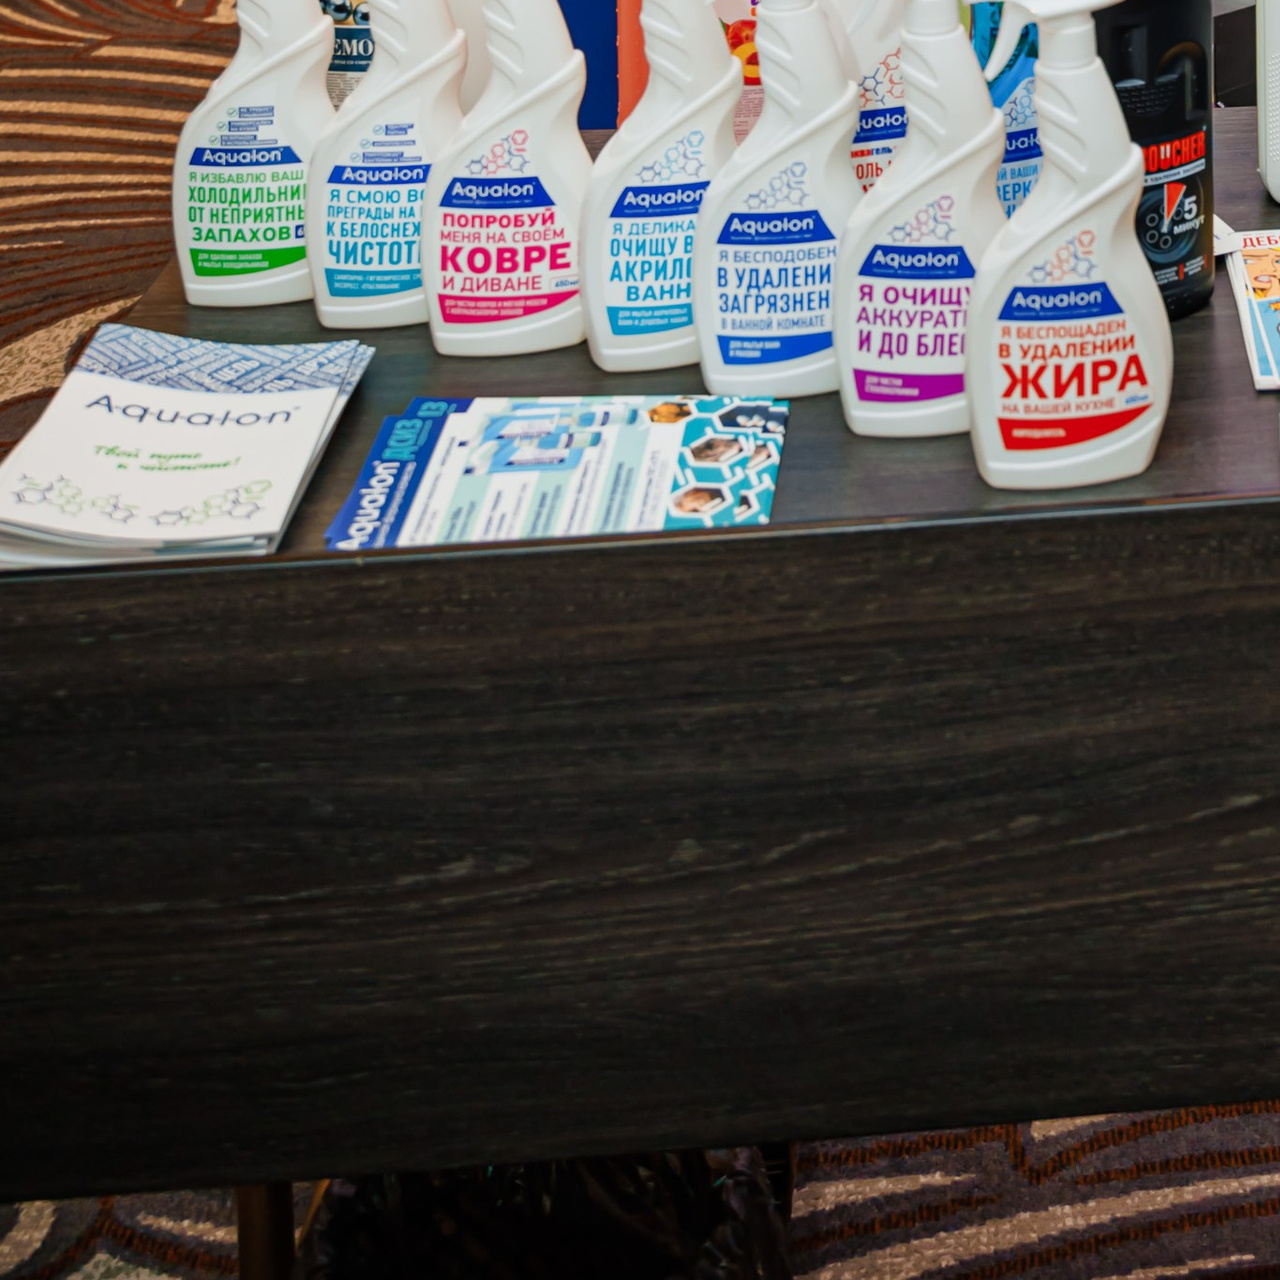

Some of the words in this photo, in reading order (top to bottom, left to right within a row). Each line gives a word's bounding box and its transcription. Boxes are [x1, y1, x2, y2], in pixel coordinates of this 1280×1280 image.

[203, 148, 281, 165] Aqualon
[189, 172, 197, 183] Я
[201, 172, 266, 184] ИЗБАВЛЮ
[342, 167, 424, 183] Aqualon
[330, 189, 341, 203] Я
[347, 189, 400, 204] СМОЮ
[451, 181, 534, 200] Aqualon
[188, 206, 204, 223] ОТ
[327, 205, 395, 220] ПРЕГРАДЫ
[400, 206, 416, 218] НА
[442, 208, 555, 228] ПОПРОБУЙ
[1184, 196, 1198, 221] 5
[192, 226, 291, 243] ЗАПАХОВ
[326, 222, 335, 237] К
[440, 230, 481, 243] МЕНЯ
[486, 231, 507, 243] НА
[512, 227, 565, 243] СВОЁМ
[612, 222, 623, 235] Я
[729, 217, 814, 236] Aqualon
[610, 236, 677, 259] ОЧИЩУ
[719, 250, 729, 262] Я
[733, 245, 837, 264] БЕСПОДОБЕН
[440, 242, 571, 274] КОВРЕ
[872, 249, 959, 269] Aqualon
[442, 276, 455, 290] И
[459, 275, 542, 293] ДИВАНЕ
[717, 268, 728, 287] В
[858, 284, 874, 302] Я
[1012, 290, 1102, 310] Aqualon
[733, 316, 774, 331] ВАННОЙ
[776, 315, 826, 330] КОМНАТЕ
[1001, 325, 1011, 338] Я
[1016, 319, 1127, 340] БЕСПОЩАДЕН
[858, 332, 871, 353] И
[878, 333, 908, 358] ДО
[999, 343, 1011, 359] В
[1019, 335, 1136, 362] УДАЛЕНИИ
[1001, 354, 1149, 399] ЖИРА
[1002, 402, 1020, 415] НА
[1024, 397, 1071, 414] ВАШЕЙ
[1074, 395, 1116, 412] КУХНЕ
[337, 460, 399, 550] Aqualon
